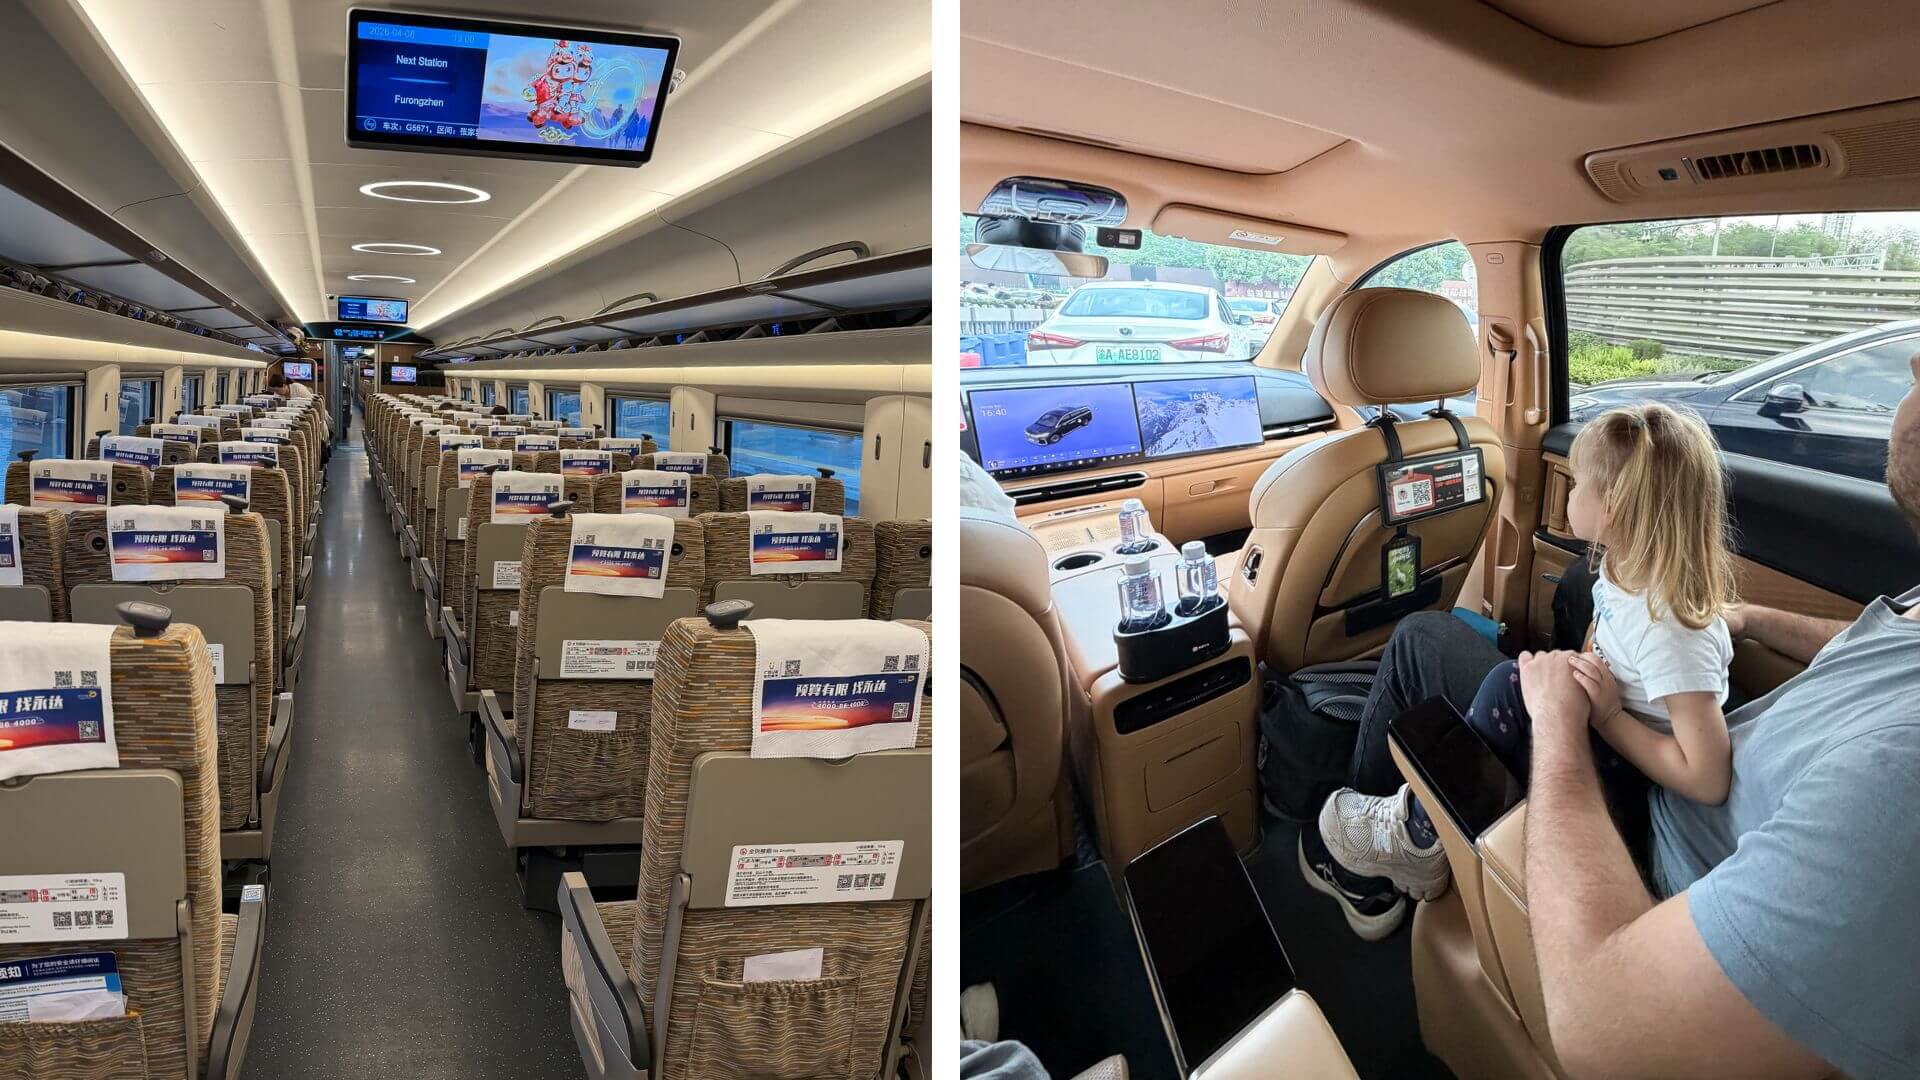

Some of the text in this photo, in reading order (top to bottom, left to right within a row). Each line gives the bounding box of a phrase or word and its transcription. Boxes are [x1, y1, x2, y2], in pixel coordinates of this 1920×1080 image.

[396, 54, 448, 68] Next Station
[394, 94, 444, 107] Furongzhen
[982, 408, 1007, 417] 16:40
[15, 695, 64, 713] 找永达
